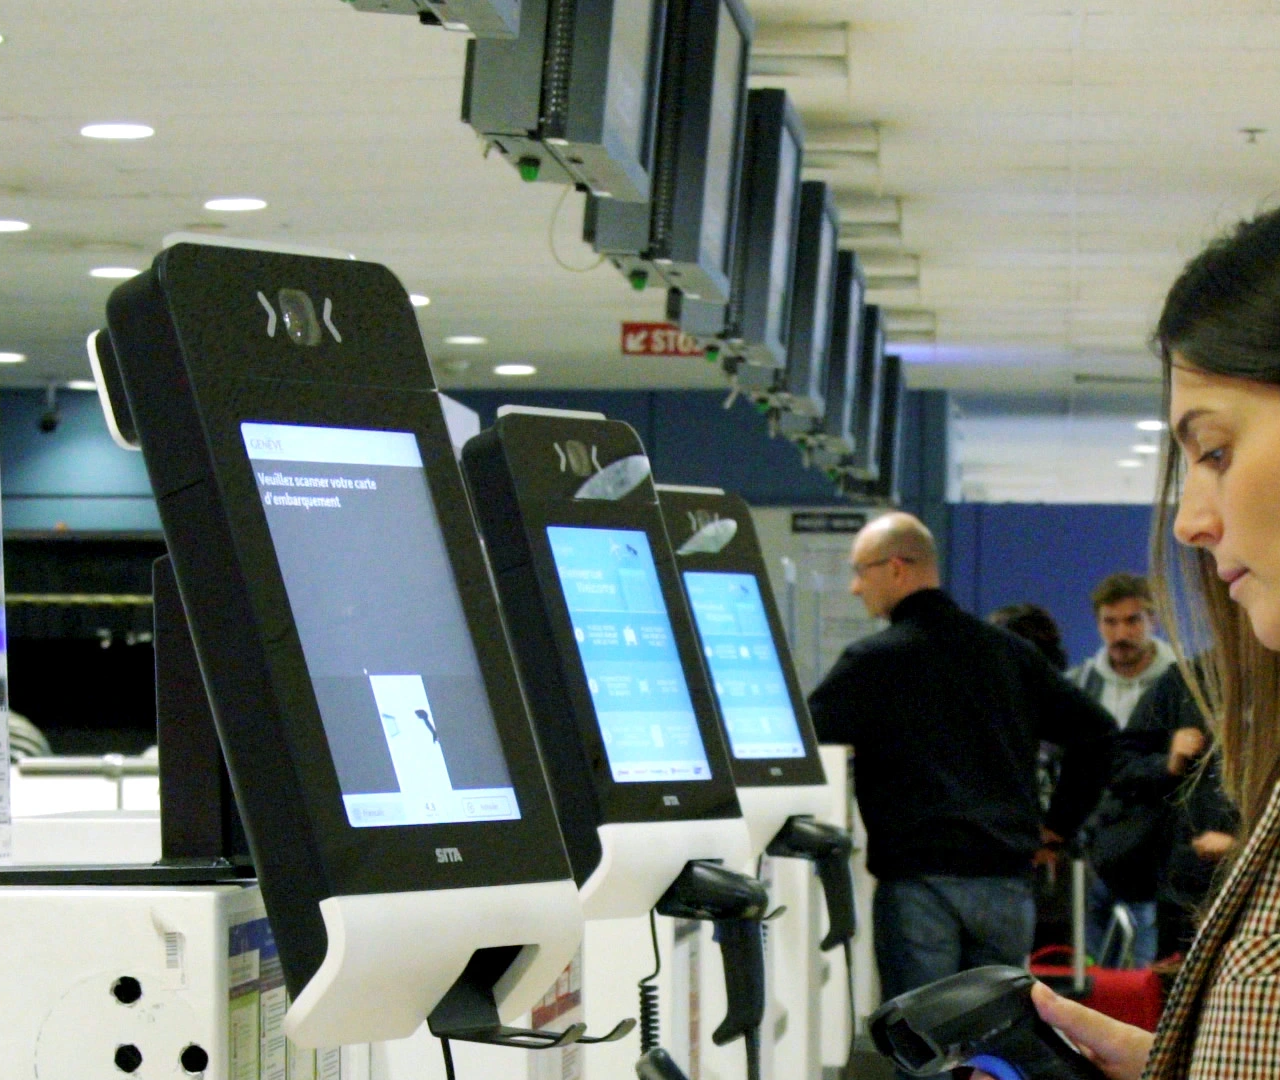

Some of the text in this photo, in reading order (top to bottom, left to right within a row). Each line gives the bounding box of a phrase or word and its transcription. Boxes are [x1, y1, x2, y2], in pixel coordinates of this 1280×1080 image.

[257, 472, 377, 490] Veuillez scanner votre carte
[435, 847, 463, 863] SITA
